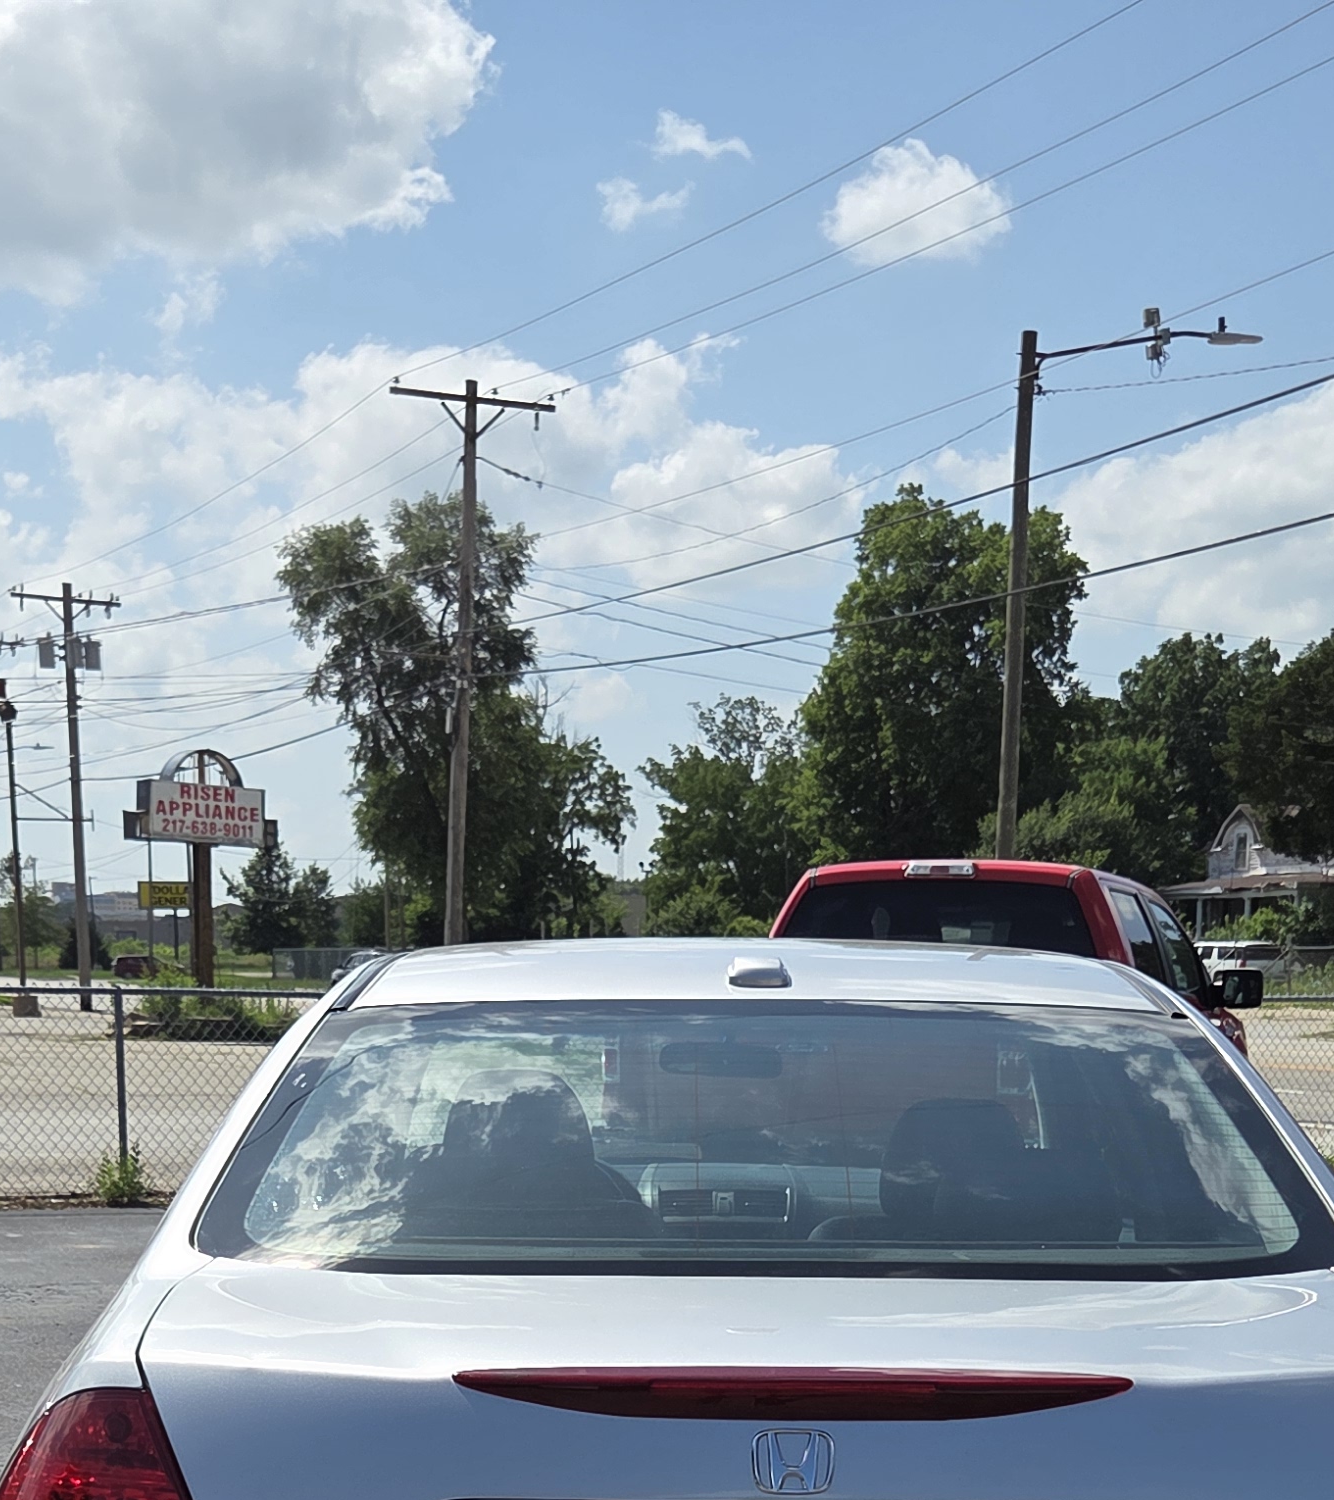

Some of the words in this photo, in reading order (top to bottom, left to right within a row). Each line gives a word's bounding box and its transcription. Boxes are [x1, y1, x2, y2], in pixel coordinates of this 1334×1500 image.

[179, 784, 236, 804] RISEN
[155, 799, 260, 823] APPLIANCE
[161, 818, 254, 838] 217-638-9011
